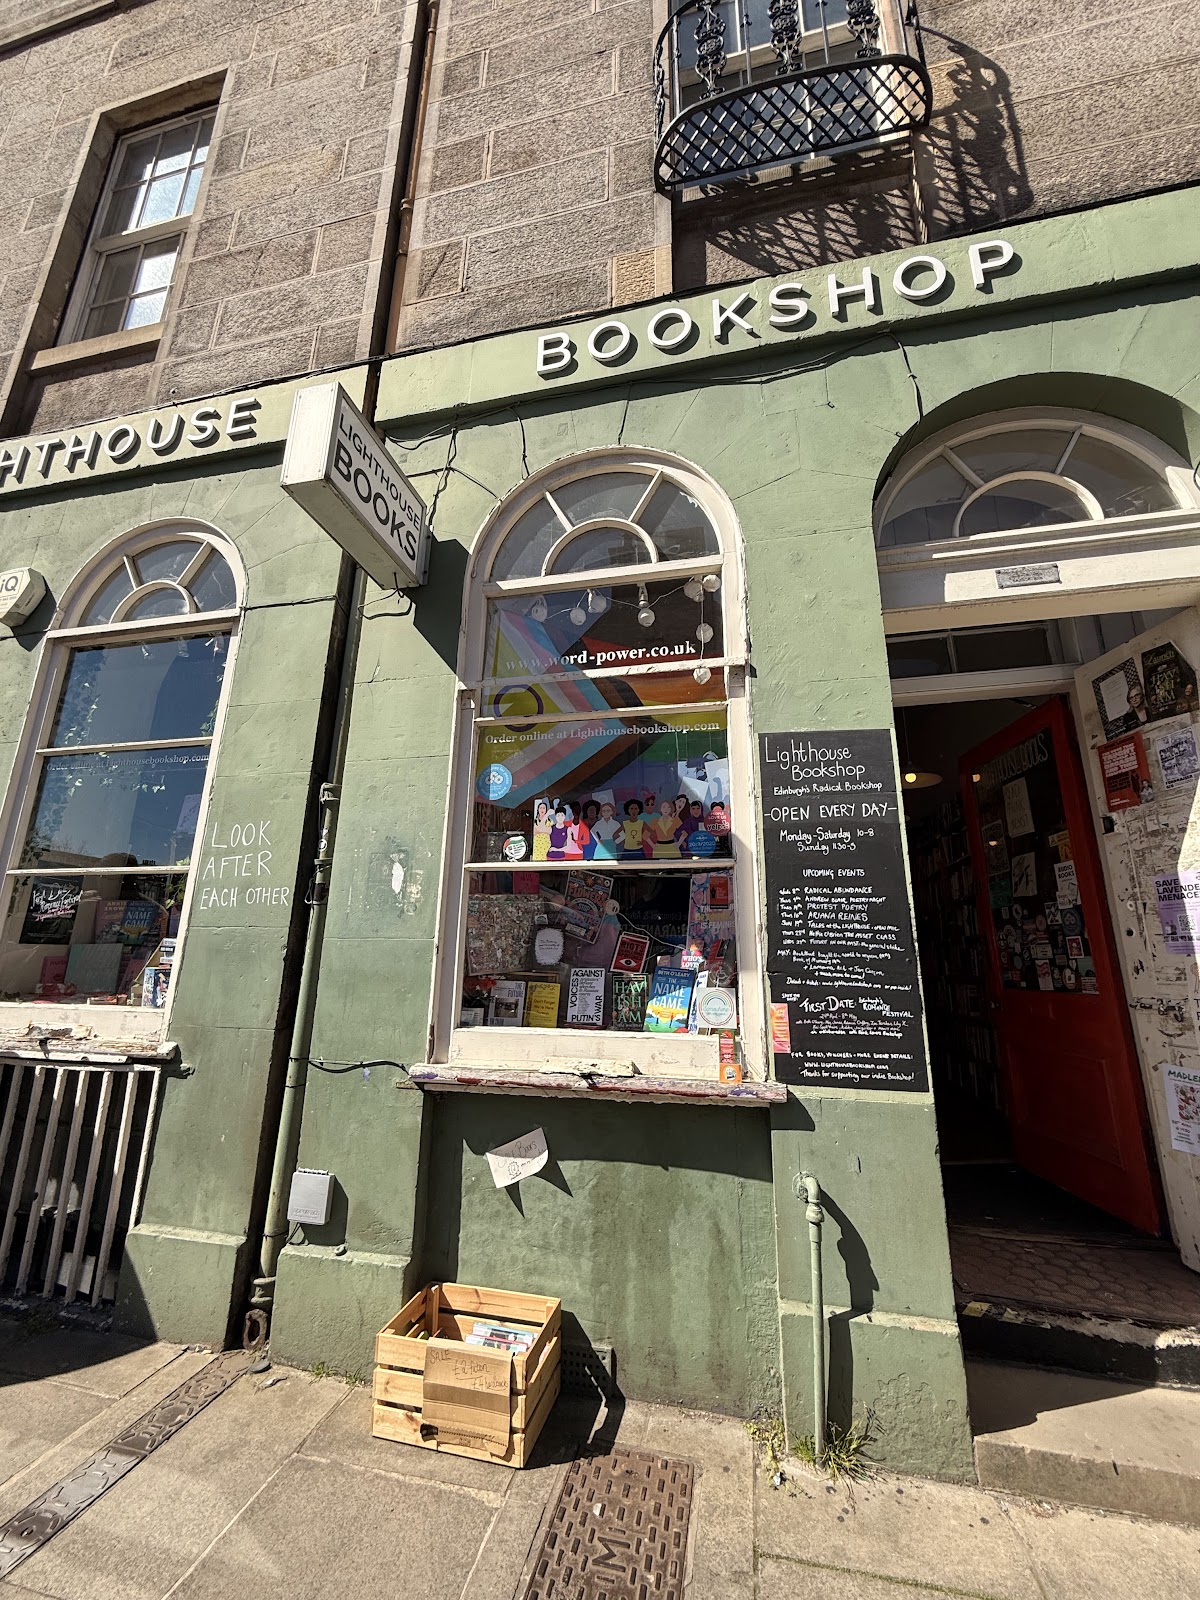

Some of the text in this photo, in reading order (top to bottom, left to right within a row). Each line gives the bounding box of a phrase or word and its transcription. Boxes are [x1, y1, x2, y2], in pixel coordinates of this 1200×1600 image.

[536, 239, 1015, 375] BOOKSHOP
[339, 413, 421, 529] LIGHTHOUSE
[333, 438, 417, 563] BOOKS
[506, 641, 696, 671] www.word-power.co.uk
[485, 720, 720, 744] Order online at Lighthousebookshop.com
[765, 737, 852, 770] Lighthouse
[791, 761, 866, 781] Bookshop
[773, 781, 883, 796] Edinburgh's Radical Bookshop
[820, 803, 856, 818] EVERY
[211, 821, 272, 848] LOOK
[797, 841, 830, 856] Sunday
[203, 850, 273, 880] AFTER
[802, 869, 866, 880] UPCOMING EVENTS
[1155, 879, 1180, 888] SAVE
[200, 887, 290, 910] EACH OTHER
[841, 904, 869, 912] POETRY
[572, 969, 604, 978] AGAINST
[570, 978, 579, 1008] VOICES
[654, 983, 686, 997] NAME
[594, 994, 602, 1014] WAR
[652, 996, 685, 1010] GAME
[799, 998, 827, 1013] FIRST
[571, 1014, 601, 1022] PUTIN'S
[800, 1069, 821, 1077] Thanks
[430, 1349, 452, 1364] SALE
